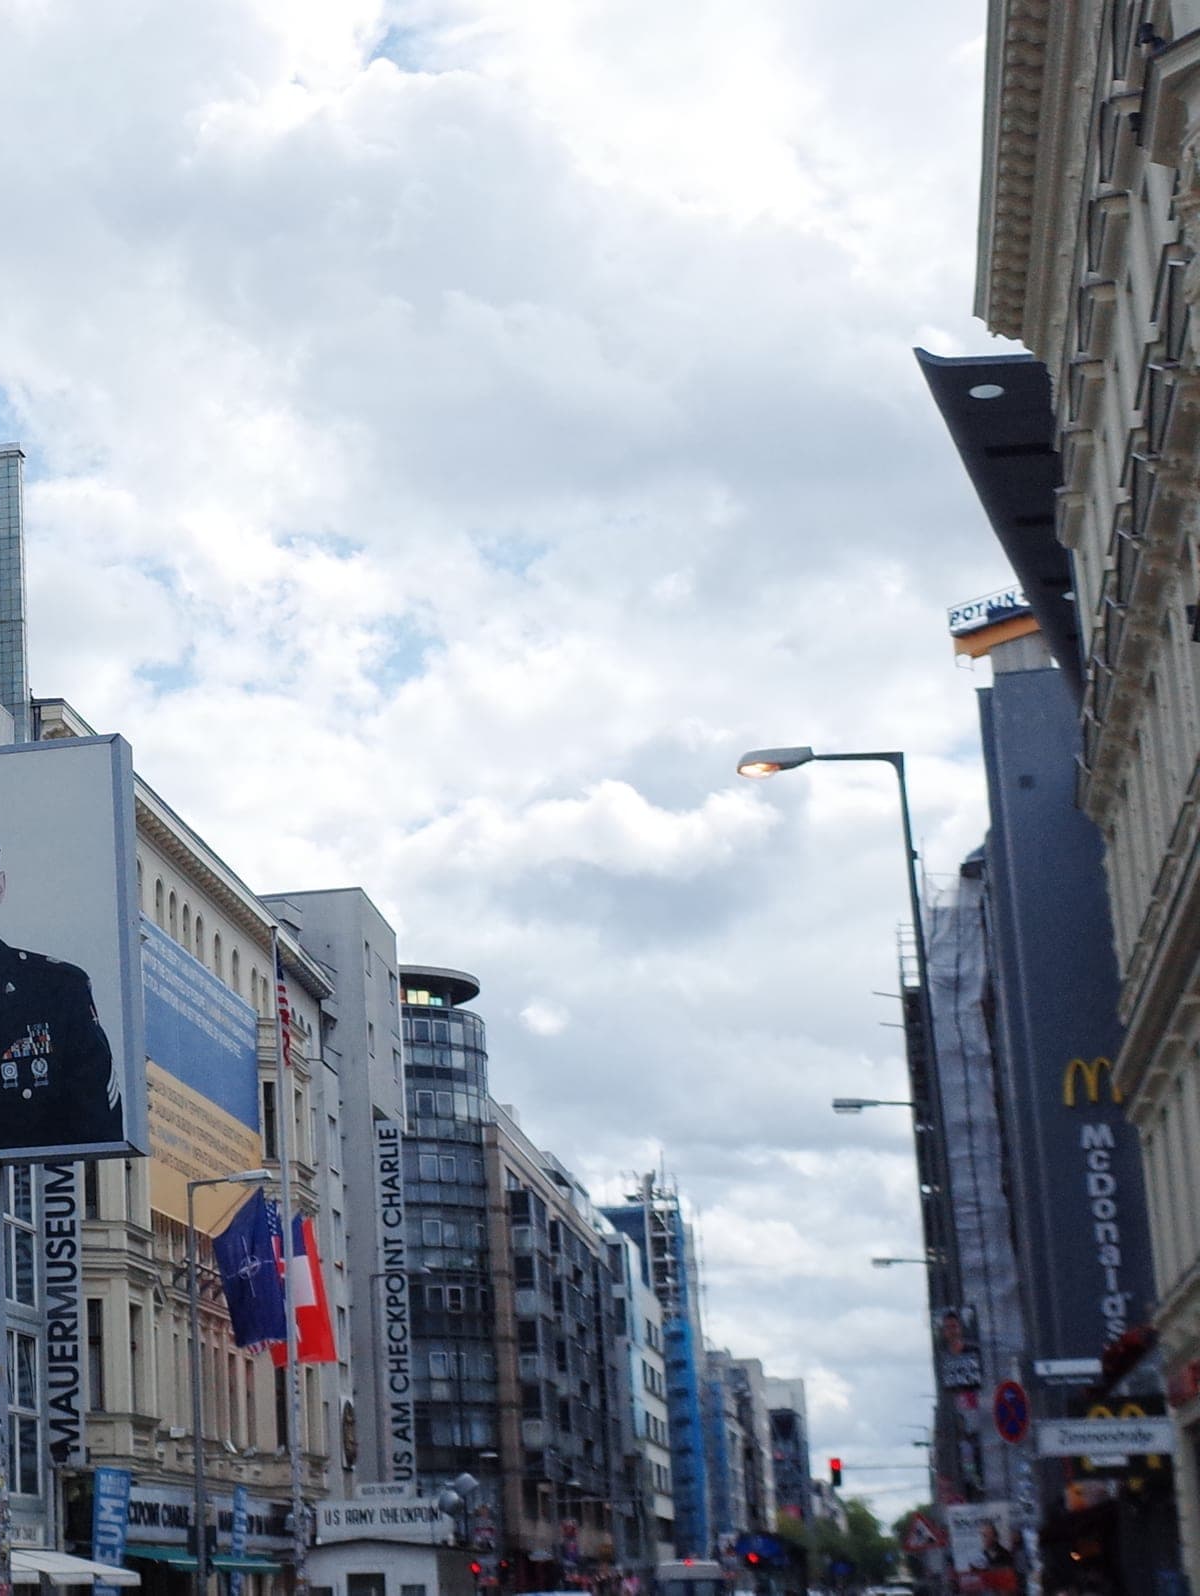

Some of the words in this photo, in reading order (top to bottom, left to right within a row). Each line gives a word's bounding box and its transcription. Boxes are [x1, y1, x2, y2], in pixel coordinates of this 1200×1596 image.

[378, 1127, 402, 1228] CHARLIE
[44, 1161, 81, 1456] MAUERMUSEUM
[383, 1236, 410, 1394] CHECKPOINT
[390, 1402, 412, 1443] AM
[392, 1451, 413, 1482] US
[324, 1509, 341, 1526] US
[345, 1507, 375, 1526] ARMY
